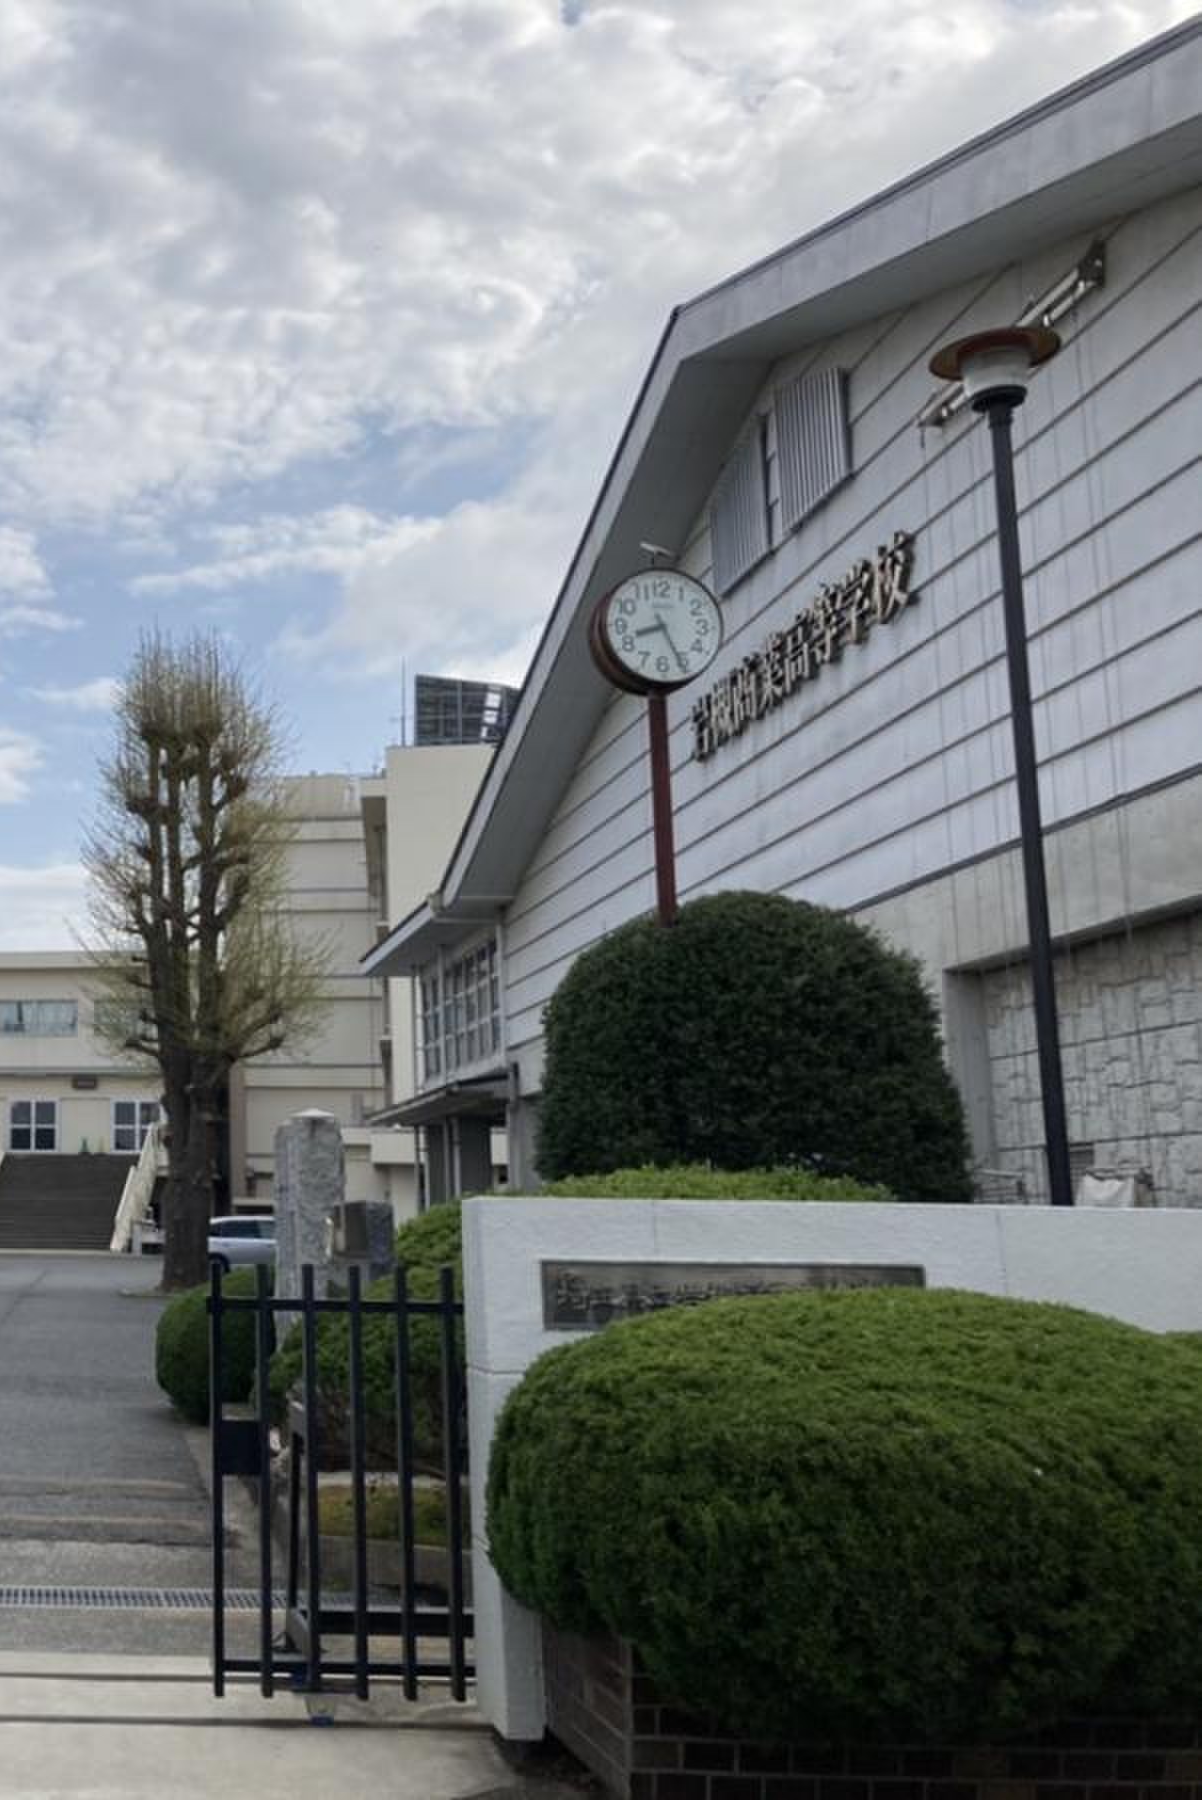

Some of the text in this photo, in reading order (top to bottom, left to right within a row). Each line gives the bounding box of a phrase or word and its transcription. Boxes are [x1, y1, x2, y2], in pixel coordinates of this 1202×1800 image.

[633, 582, 649, 601] 11
[653, 580, 671, 598] 12
[677, 586, 685, 602] 1
[617, 598, 637, 616] 10
[689, 598, 703, 617] 2
[614, 617, 627, 636] 9
[695, 618, 709, 636] 3
[621, 635, 635, 653] 8
[690, 639, 703, 653] 4
[637, 649, 651, 667] 7
[656, 656, 670, 673] 6
